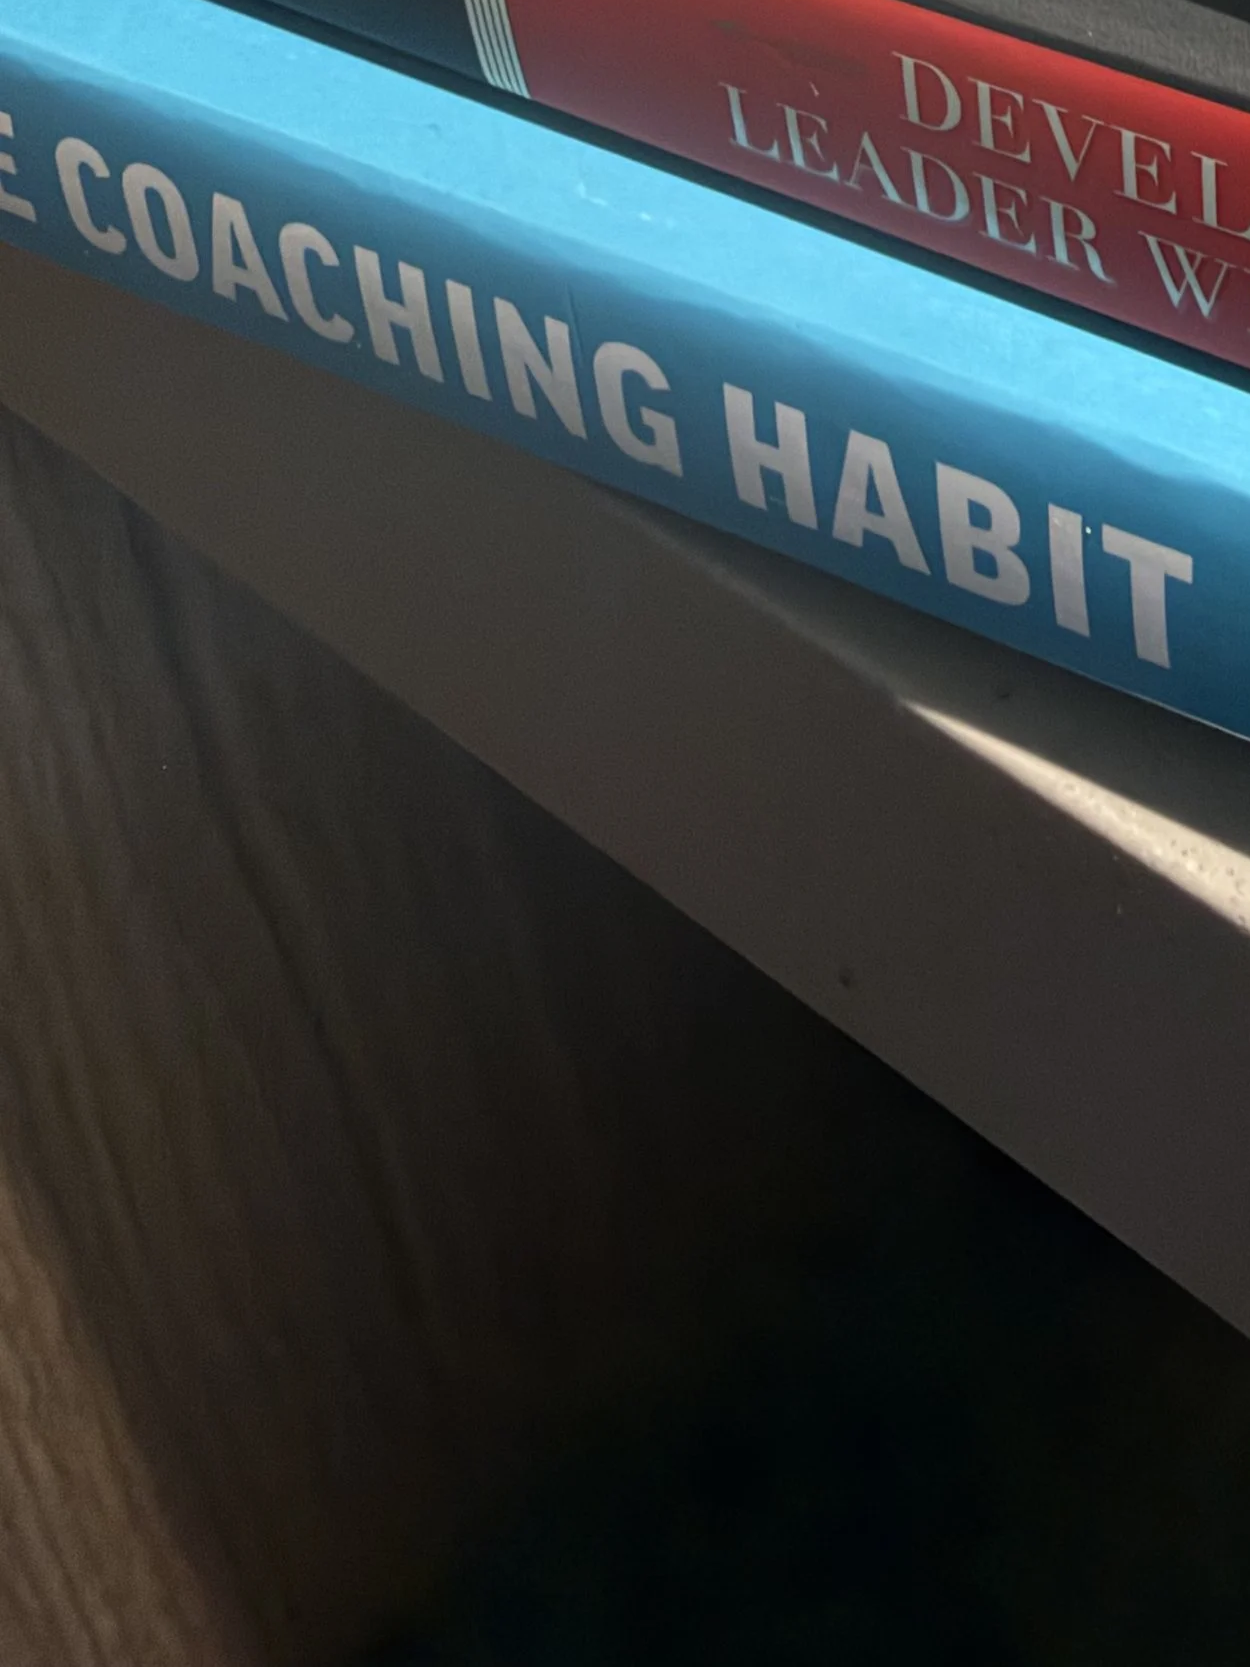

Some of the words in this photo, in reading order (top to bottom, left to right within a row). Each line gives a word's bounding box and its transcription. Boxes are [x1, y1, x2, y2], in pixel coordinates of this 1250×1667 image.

[718, 81, 1116, 284] LEADER
[55, 136, 684, 478] COACHING
[723, 381, 1194, 670] HABIT
